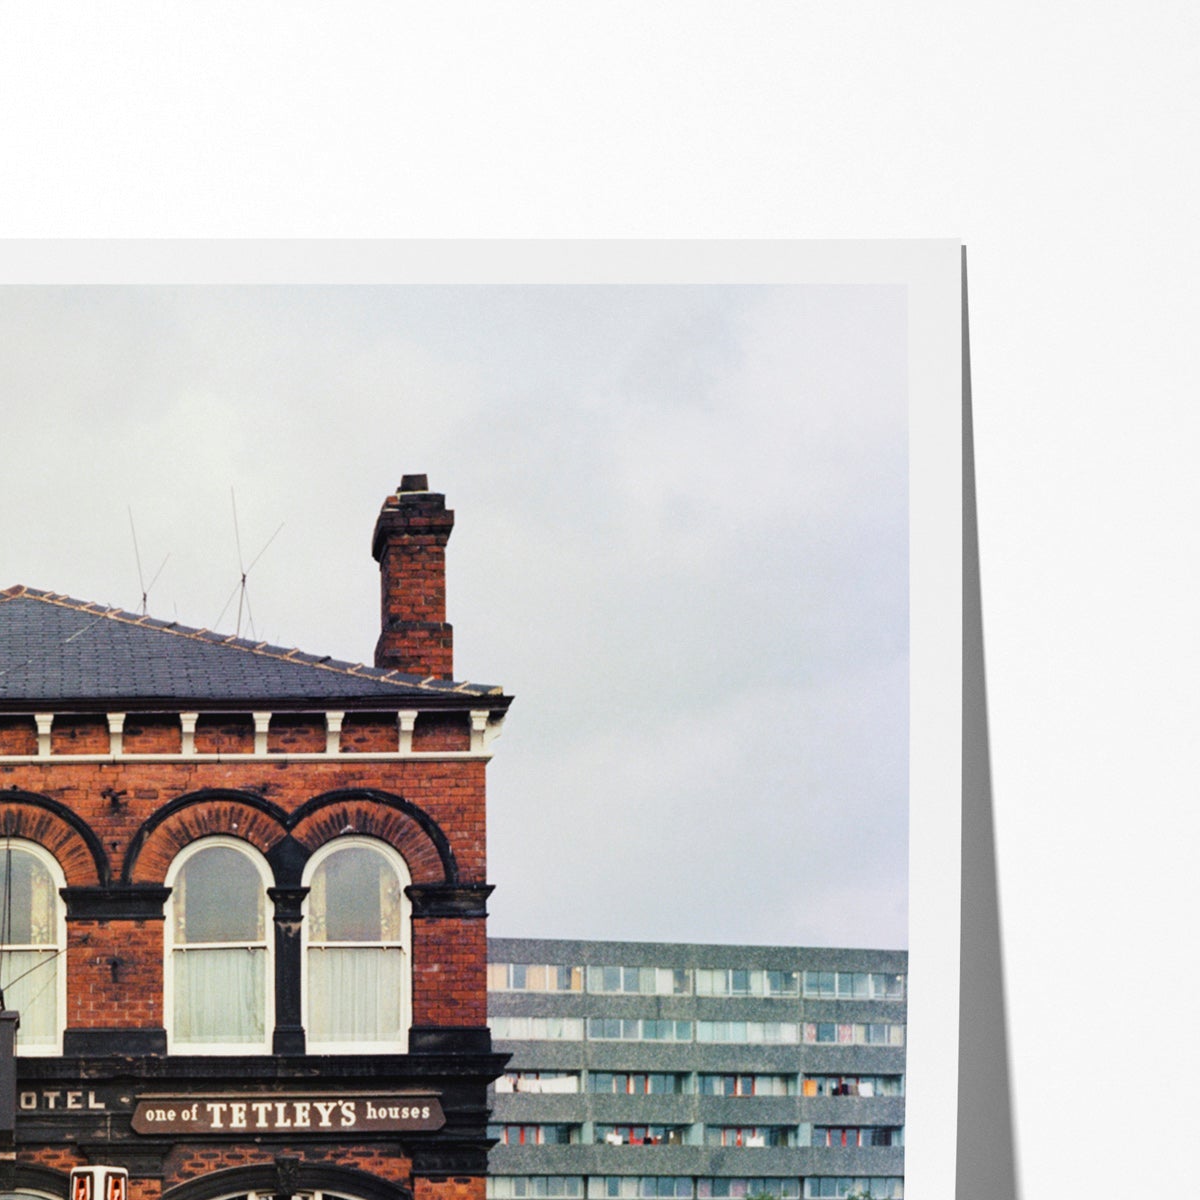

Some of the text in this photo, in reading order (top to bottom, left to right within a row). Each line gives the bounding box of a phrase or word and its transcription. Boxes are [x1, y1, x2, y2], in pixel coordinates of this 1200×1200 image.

[19, 1091, 106, 1110] OTEL
[145, 1100, 431, 1128] one of TETLEY'S houses
